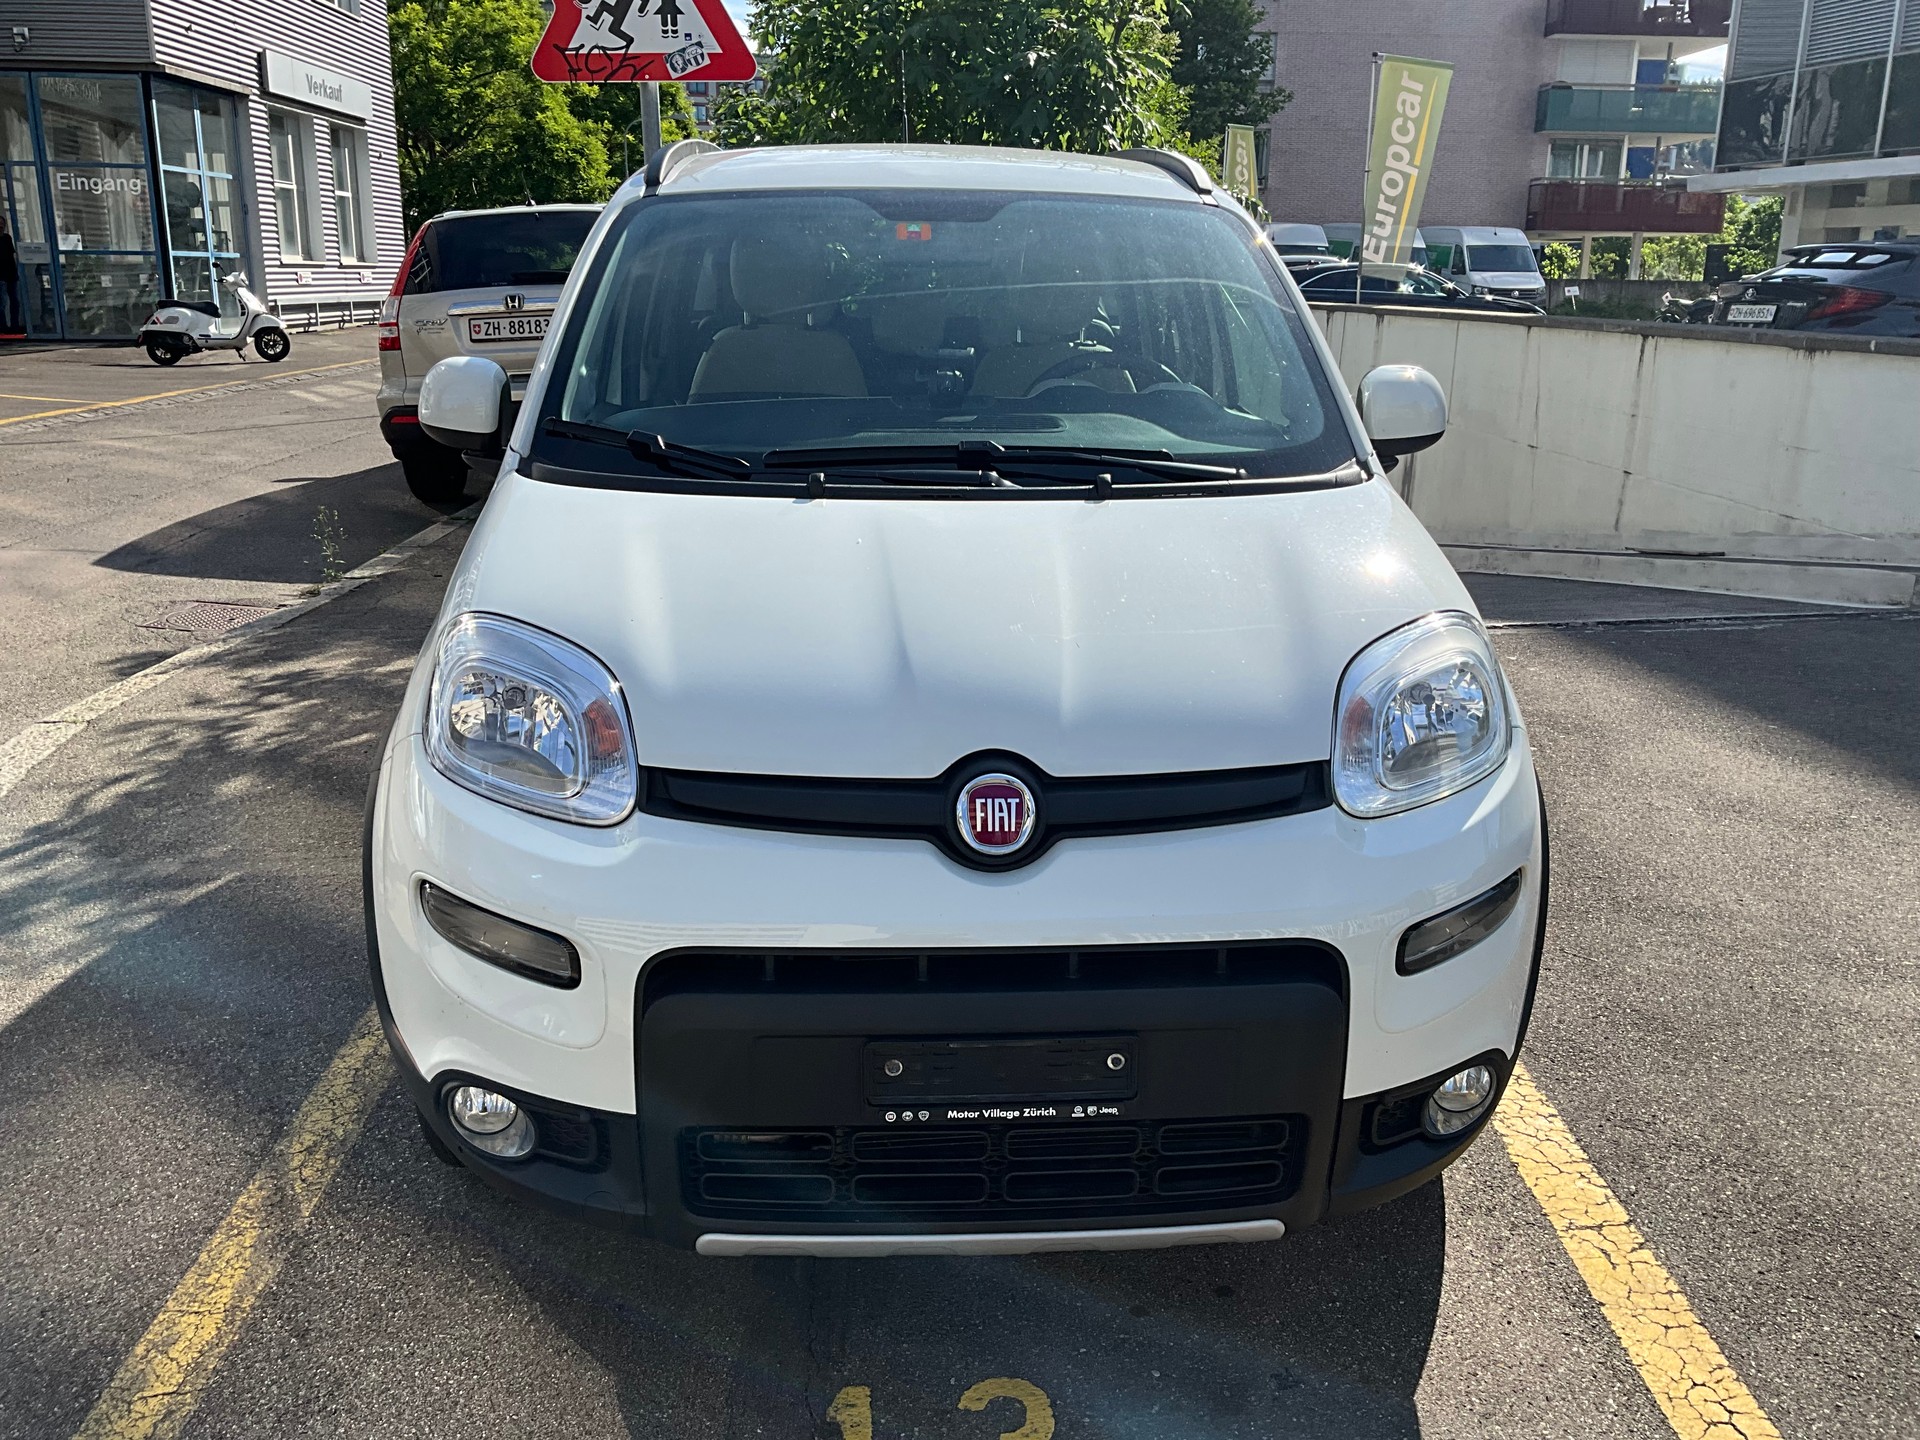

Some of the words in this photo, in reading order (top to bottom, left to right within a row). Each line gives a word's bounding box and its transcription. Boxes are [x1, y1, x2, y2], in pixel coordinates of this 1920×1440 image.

[305, 73, 343, 103] Verkauf
[1363, 70, 1425, 264] Europcar
[56, 172, 142, 195] Eingang
[975, 798, 1020, 832] FIAT
[947, 1109, 980, 1119] Motor
[982, 1108, 1020, 1120] Village
[1022, 1106, 1057, 1117] Zürich
[1099, 1106, 1118, 1116] Jeep
